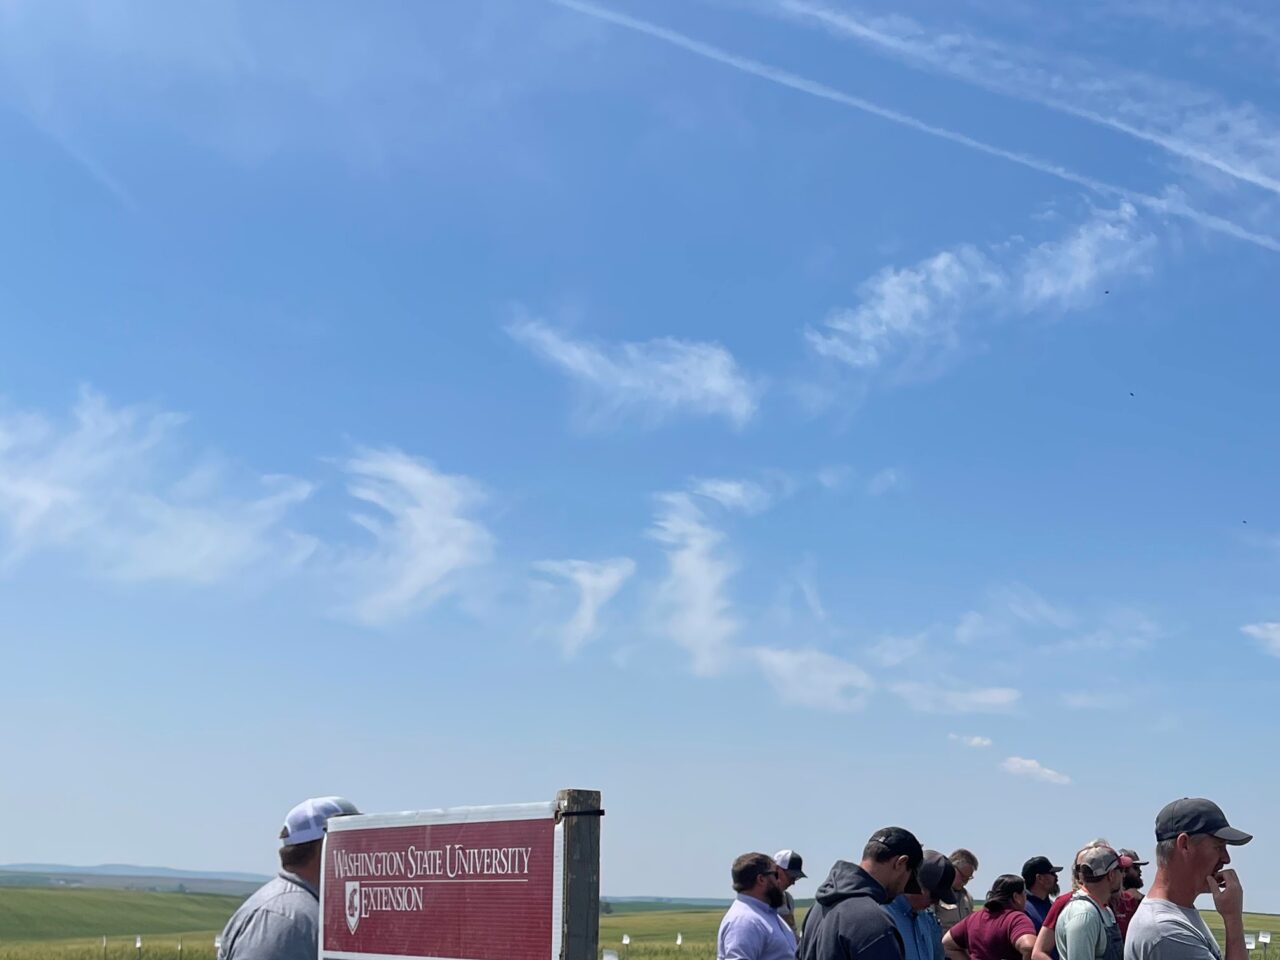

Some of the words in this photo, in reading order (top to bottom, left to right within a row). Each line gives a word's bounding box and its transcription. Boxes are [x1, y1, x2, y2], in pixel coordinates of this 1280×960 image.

[333, 849, 405, 879] WASHINGTON
[407, 845, 444, 878] STATE
[445, 844, 532, 878] UNIVERSITY
[361, 887, 424, 918] EXTENSION
